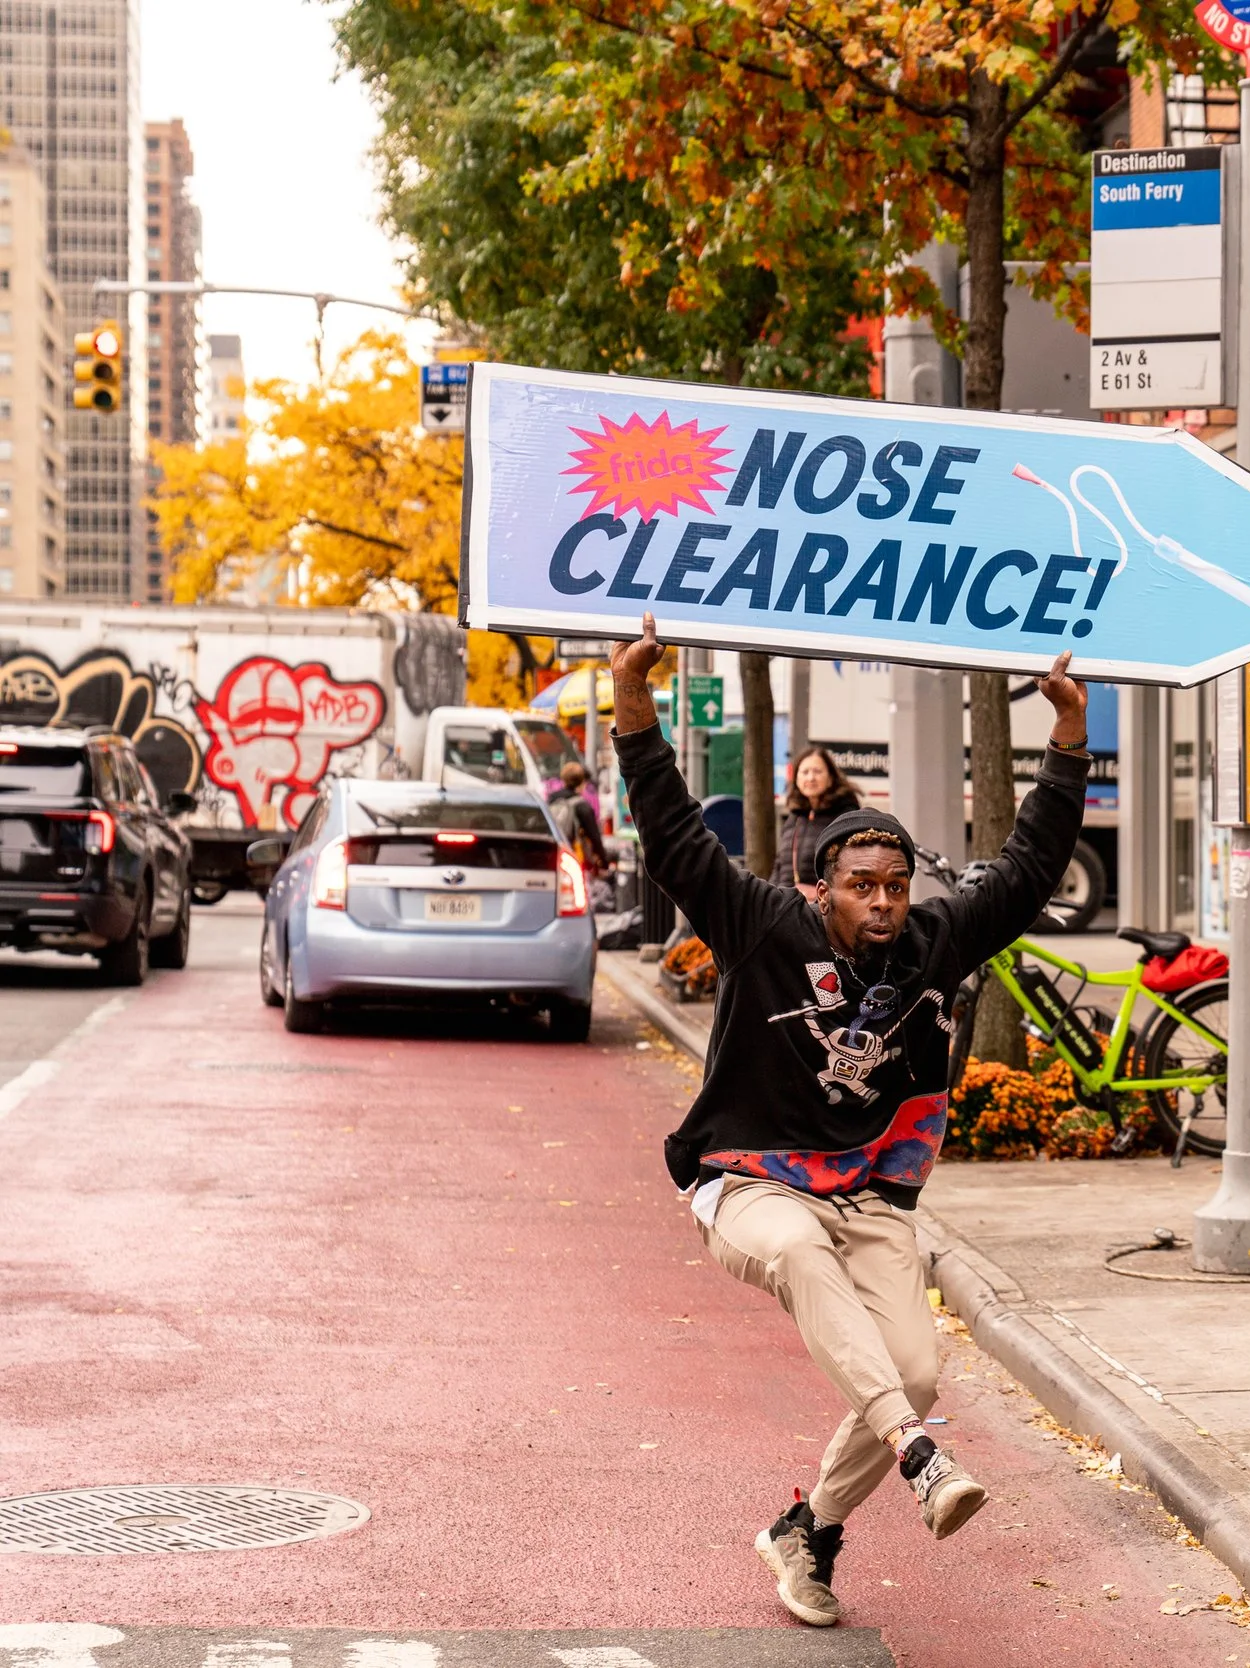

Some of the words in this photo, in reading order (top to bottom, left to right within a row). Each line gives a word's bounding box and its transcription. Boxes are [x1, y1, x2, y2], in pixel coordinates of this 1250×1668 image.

[1203, 3, 1229, 33] NO
[1100, 151, 1186, 173] Destination
[1100, 183, 1141, 203] South
[1145, 182, 1184, 203] Ferry
[1101, 350, 1110, 366] 2
[1115, 349, 1132, 366] Av
[1138, 349, 1147, 366] &
[1101, 374, 1109, 390] E
[1115, 373, 1130, 390] 61
[1137, 372, 1152, 389] St
[610, 448, 695, 485] frida
[725, 428, 981, 525] NOSE
[548, 513, 1119, 639] CLEARANCE!
